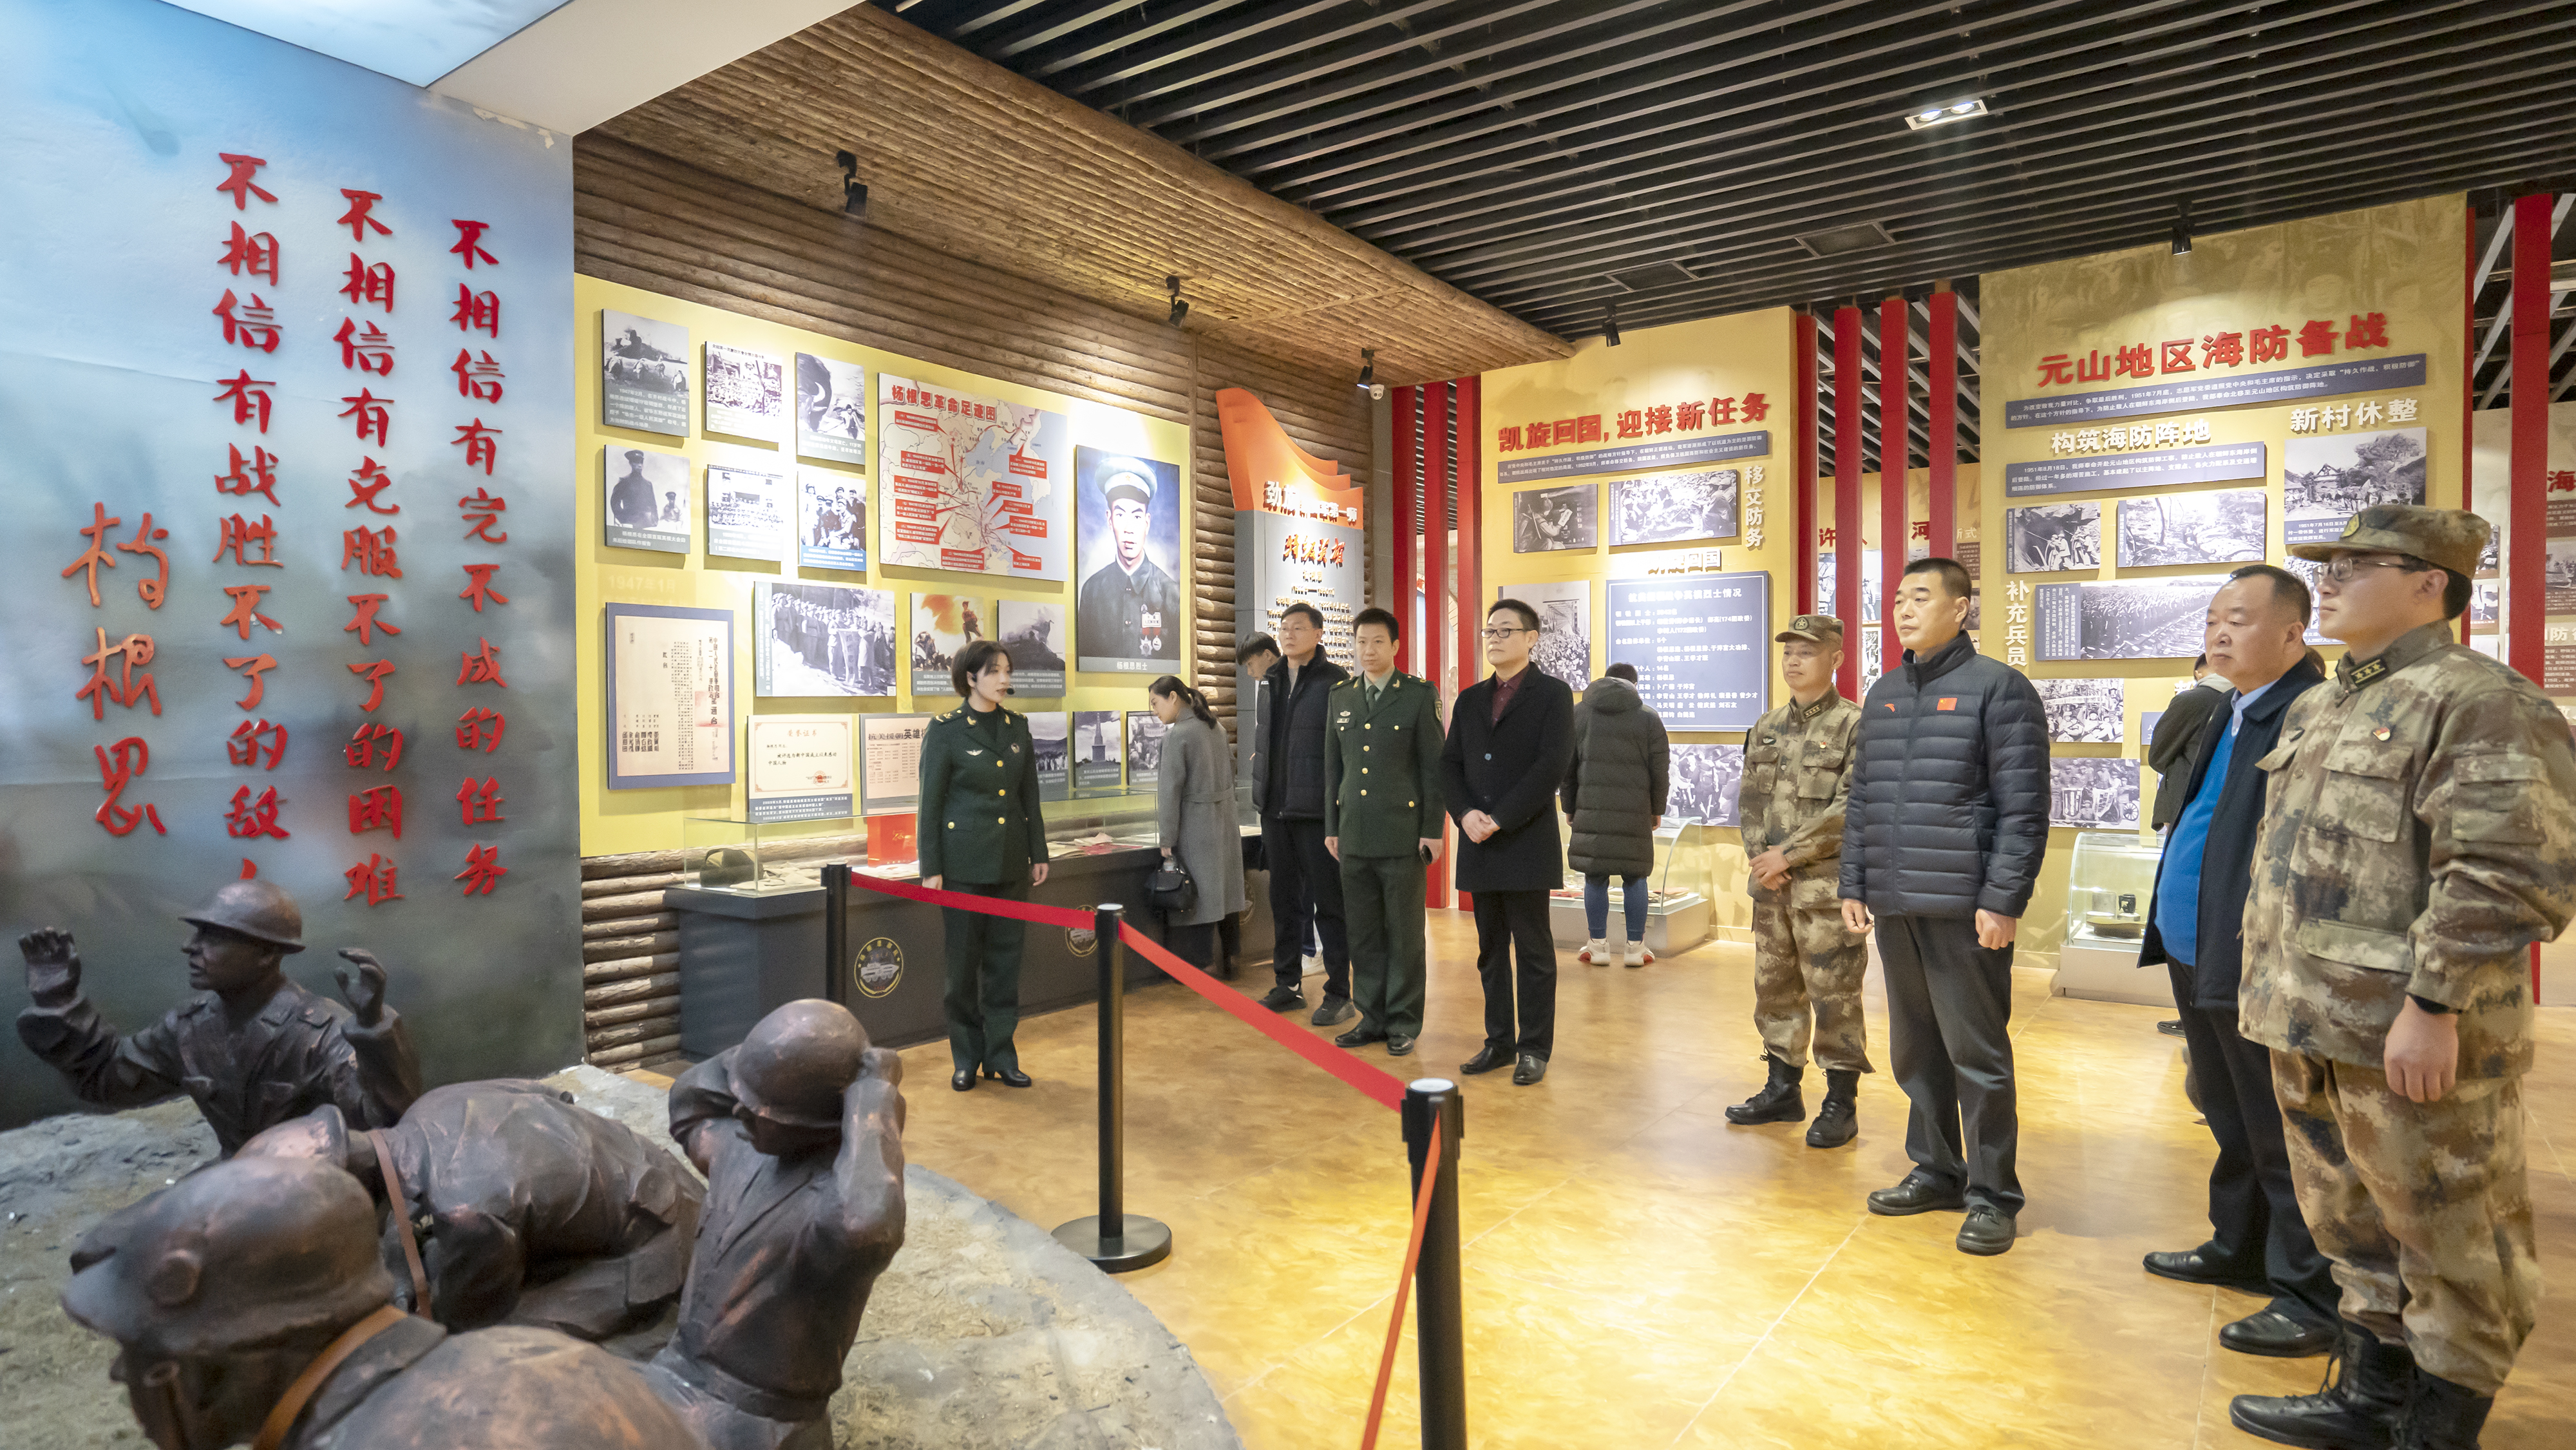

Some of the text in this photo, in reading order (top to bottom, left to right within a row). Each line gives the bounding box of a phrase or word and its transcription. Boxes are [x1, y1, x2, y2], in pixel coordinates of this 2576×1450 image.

[2037, 312, 2389, 388] 元山地区海防备战
[892, 385, 996, 422] 杨根思革命足迹图
[1498, 392, 1770, 452] 凯旋回国，迎接新任务
[2290, 398, 2418, 432] 新村休整
[2052, 417, 2211, 453] 构筑海防阵地
[1745, 465, 1764, 549] 移交防务
[333, 189, 404, 906] 不相信有克服不了的困难
[450, 220, 508, 895] 不相信有完不成的任务
[2005, 580, 2029, 667] 补充兵员
[1117, 661, 1148, 671] 杨根思烈士
[868, 729, 926, 740] 抗美援朝英雄
